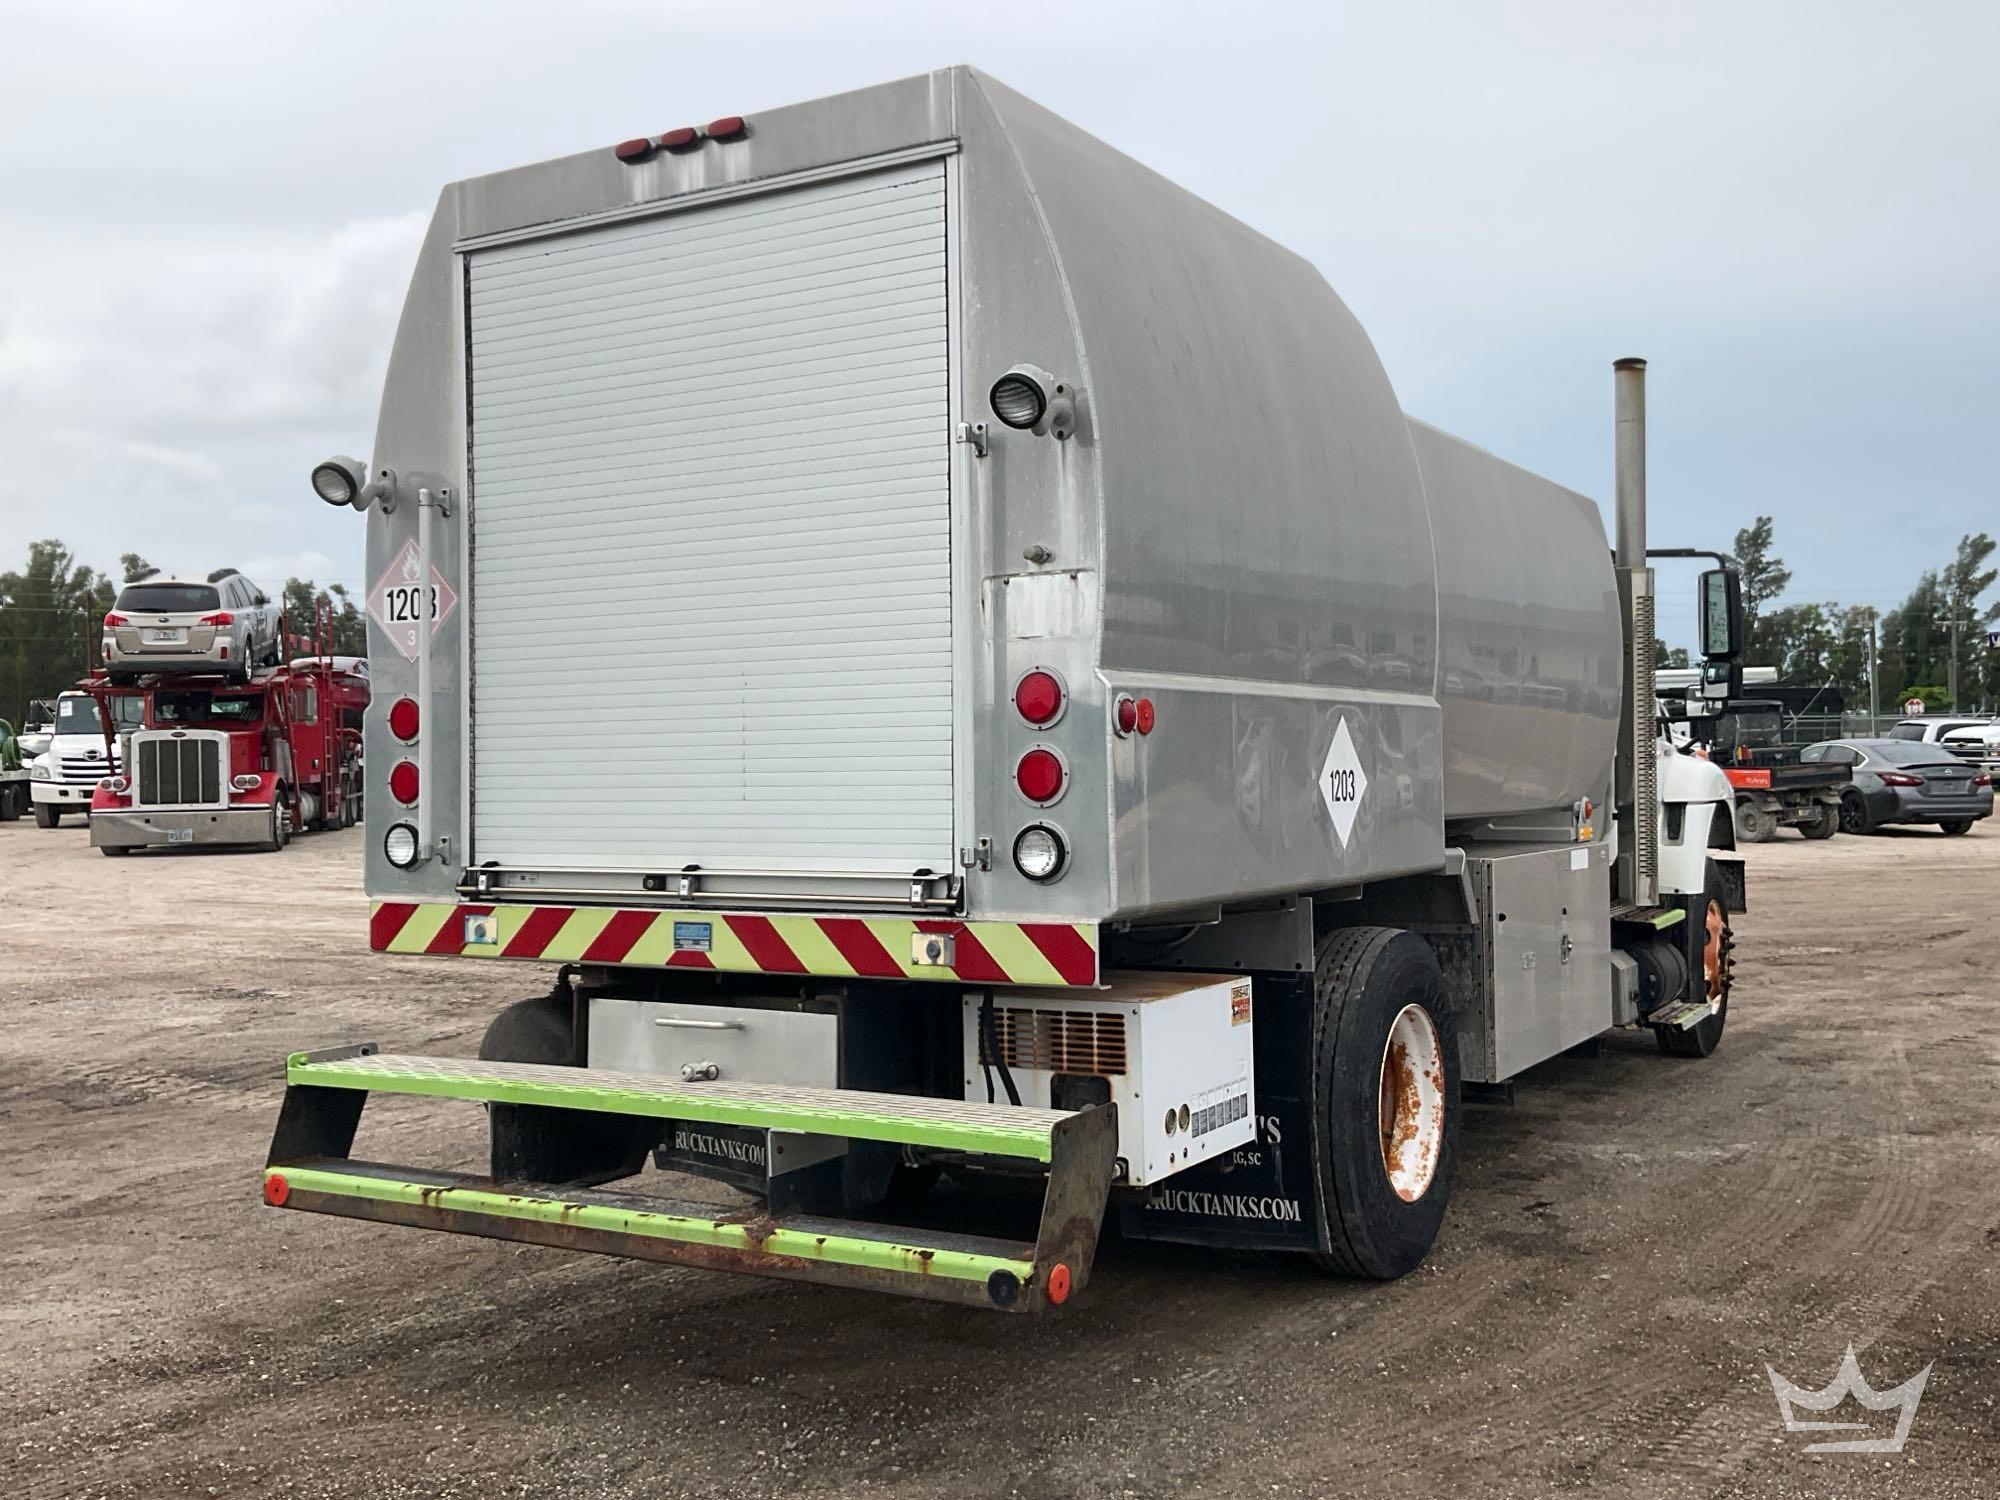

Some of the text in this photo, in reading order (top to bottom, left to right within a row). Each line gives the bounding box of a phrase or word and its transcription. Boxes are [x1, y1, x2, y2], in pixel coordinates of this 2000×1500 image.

[407, 630, 416, 646] 3
[1330, 769, 1355, 802] 1203
[1248, 1152, 1261, 1165] SC
